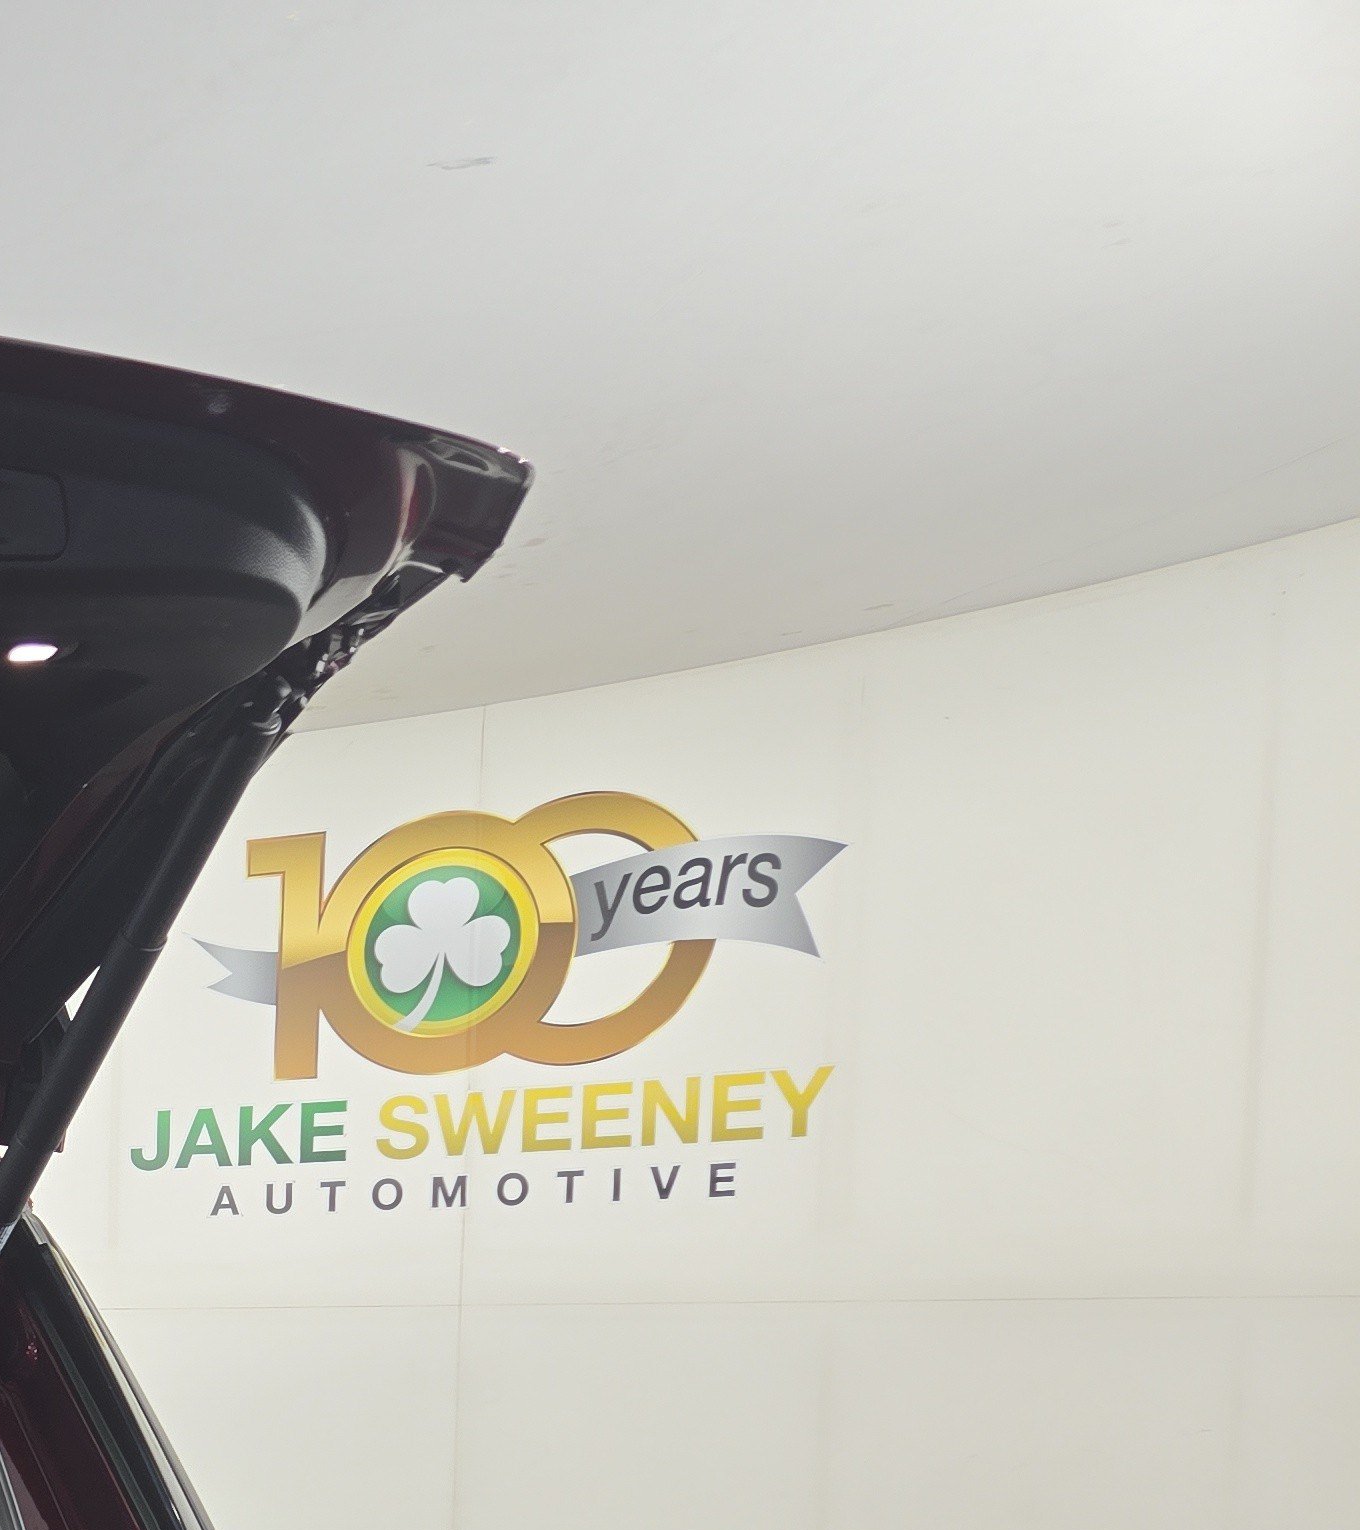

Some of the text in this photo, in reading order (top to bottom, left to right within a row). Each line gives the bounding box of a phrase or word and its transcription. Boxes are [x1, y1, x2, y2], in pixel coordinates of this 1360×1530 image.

[246, 790, 782, 1081] 100 years
[130, 1065, 836, 1171] JAKE SWEENEY
[210, 1162, 738, 1218] AUTOMOTIVE
